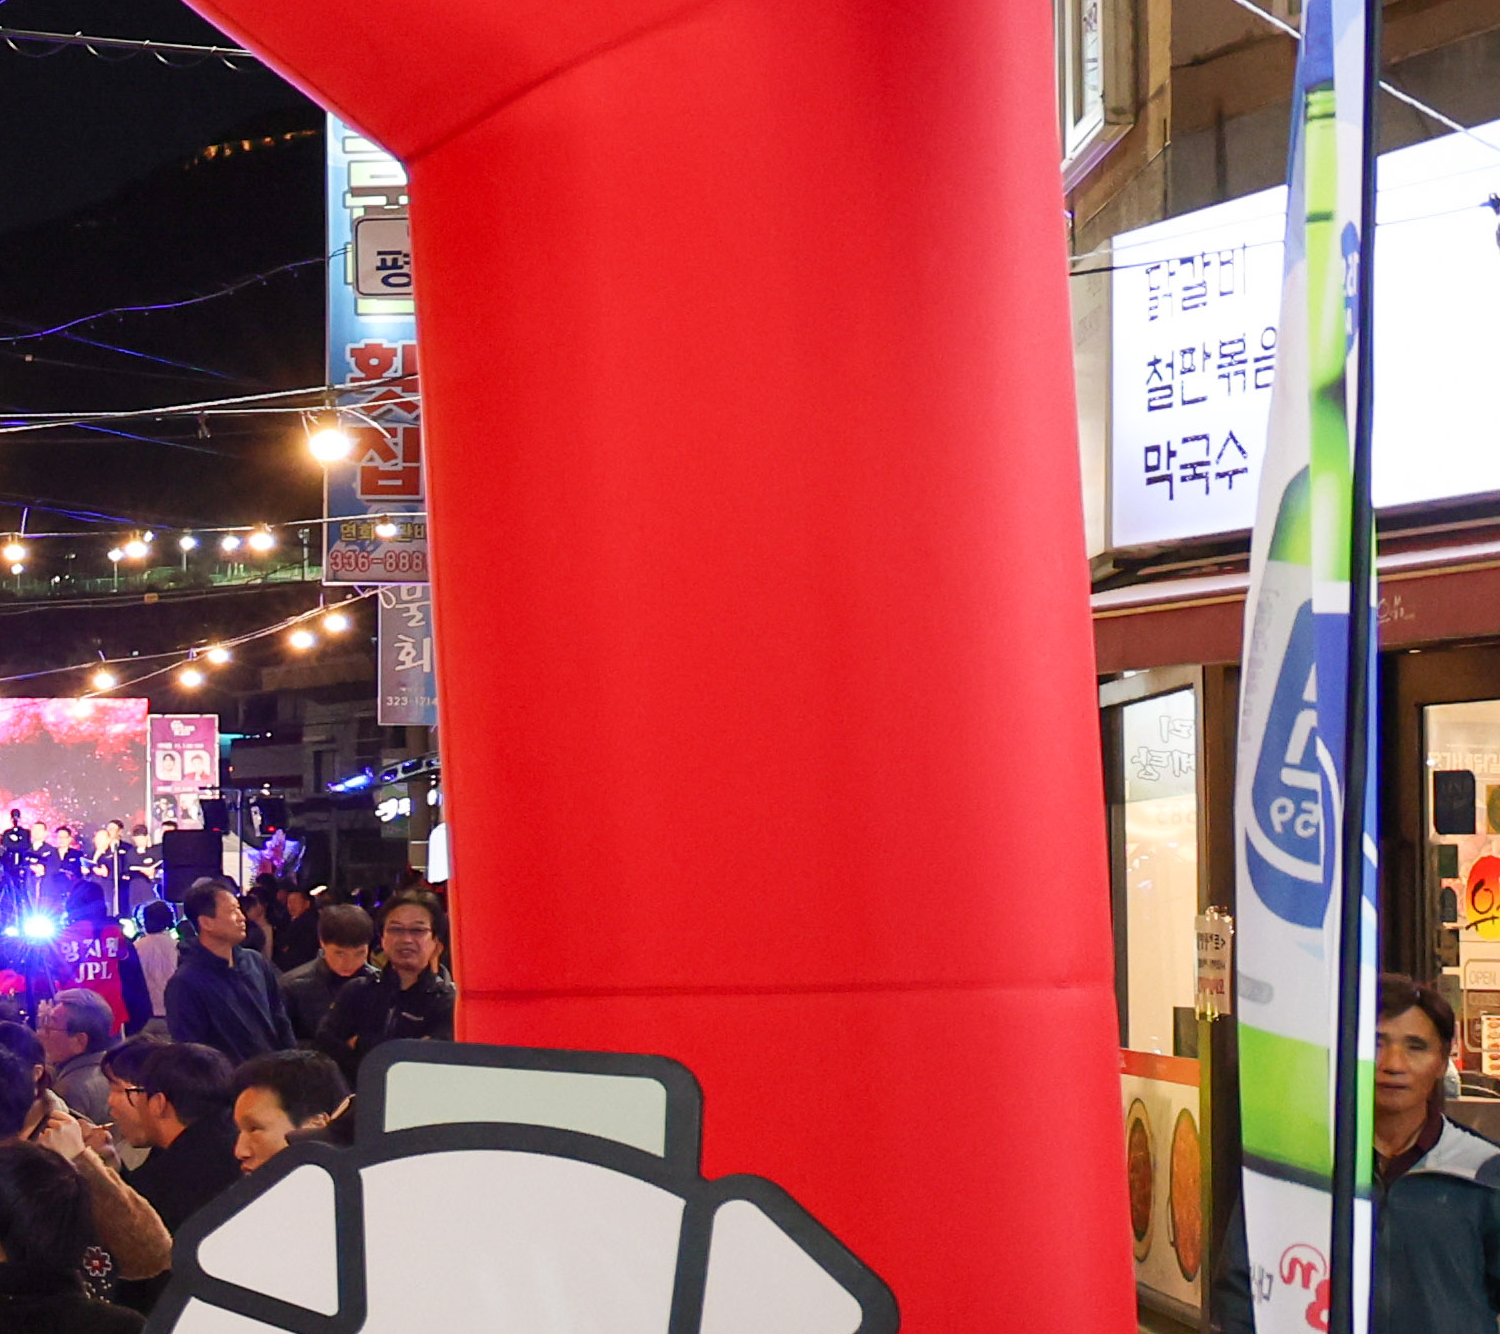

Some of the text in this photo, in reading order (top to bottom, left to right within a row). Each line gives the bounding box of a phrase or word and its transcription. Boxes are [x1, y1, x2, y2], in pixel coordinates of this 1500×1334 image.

[1144, 430, 1248, 501] 막국수
[330, 550, 429, 573] 336-888
[61, 937, 120, 963] 양지원
[75, 961, 113, 984] JPL
